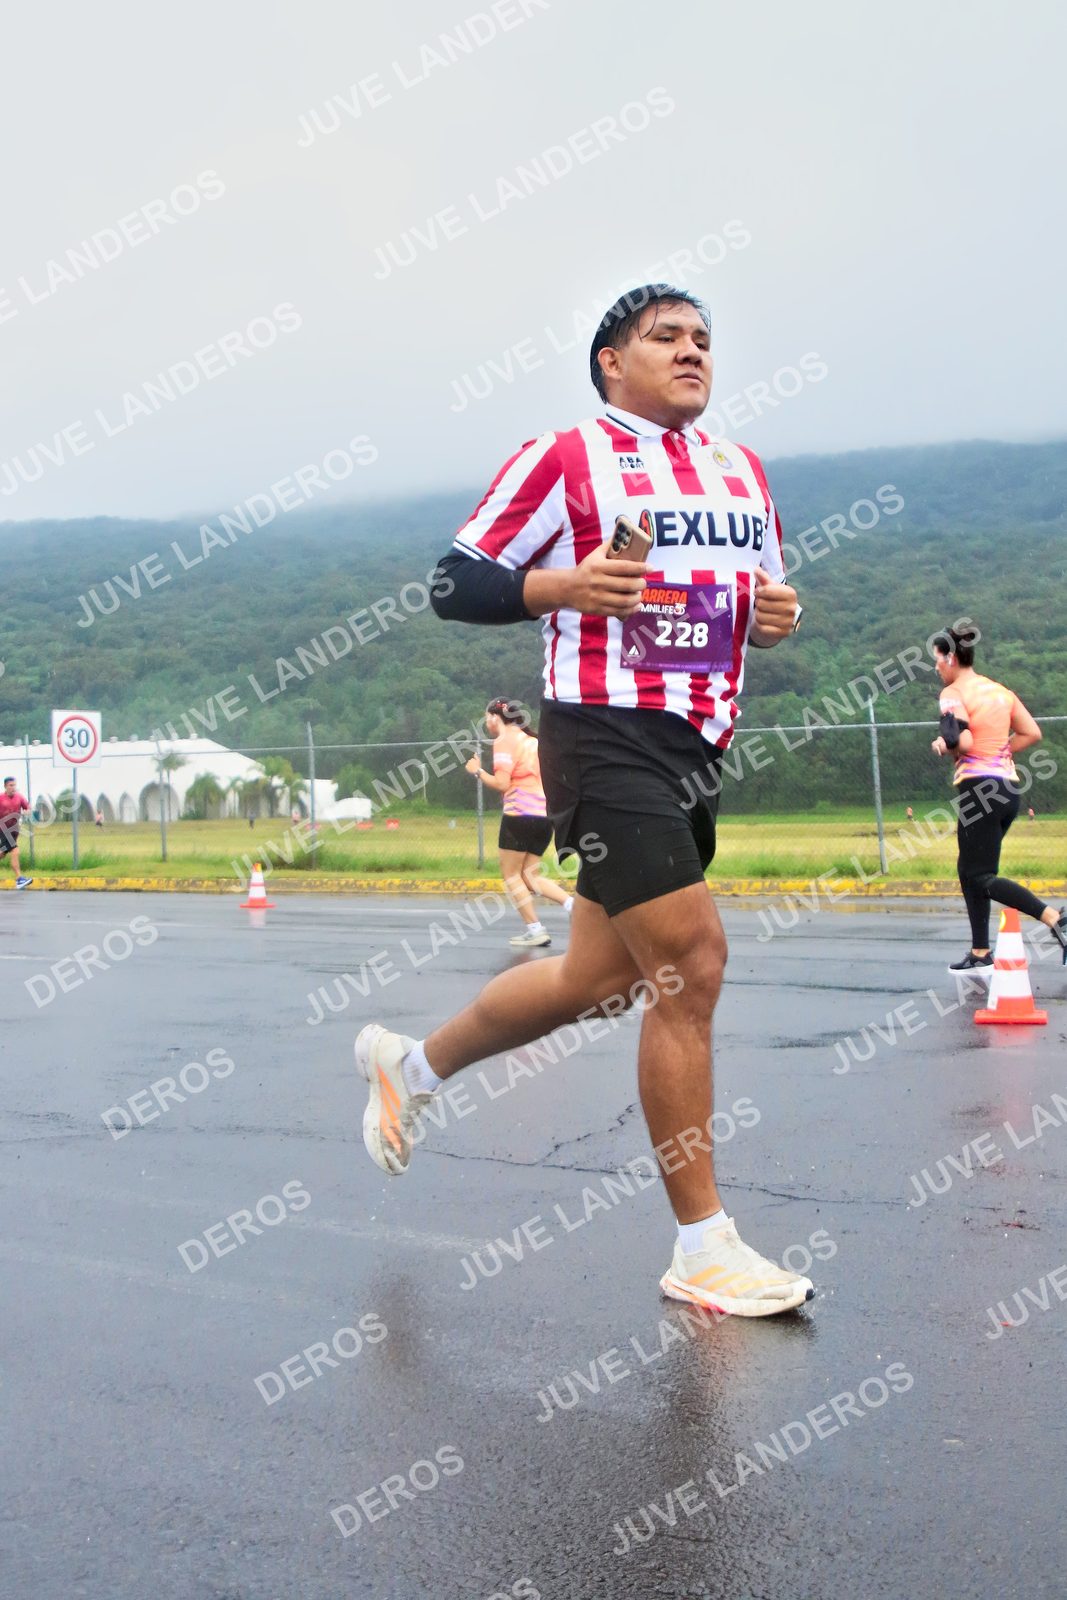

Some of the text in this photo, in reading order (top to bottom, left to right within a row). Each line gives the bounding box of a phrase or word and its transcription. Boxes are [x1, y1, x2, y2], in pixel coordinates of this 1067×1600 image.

[641, 588, 688, 604] ARRERA
[640, 603, 674, 614] MNILIFE
[654, 620, 709, 648] 228
[64, 728, 90, 749] 30
